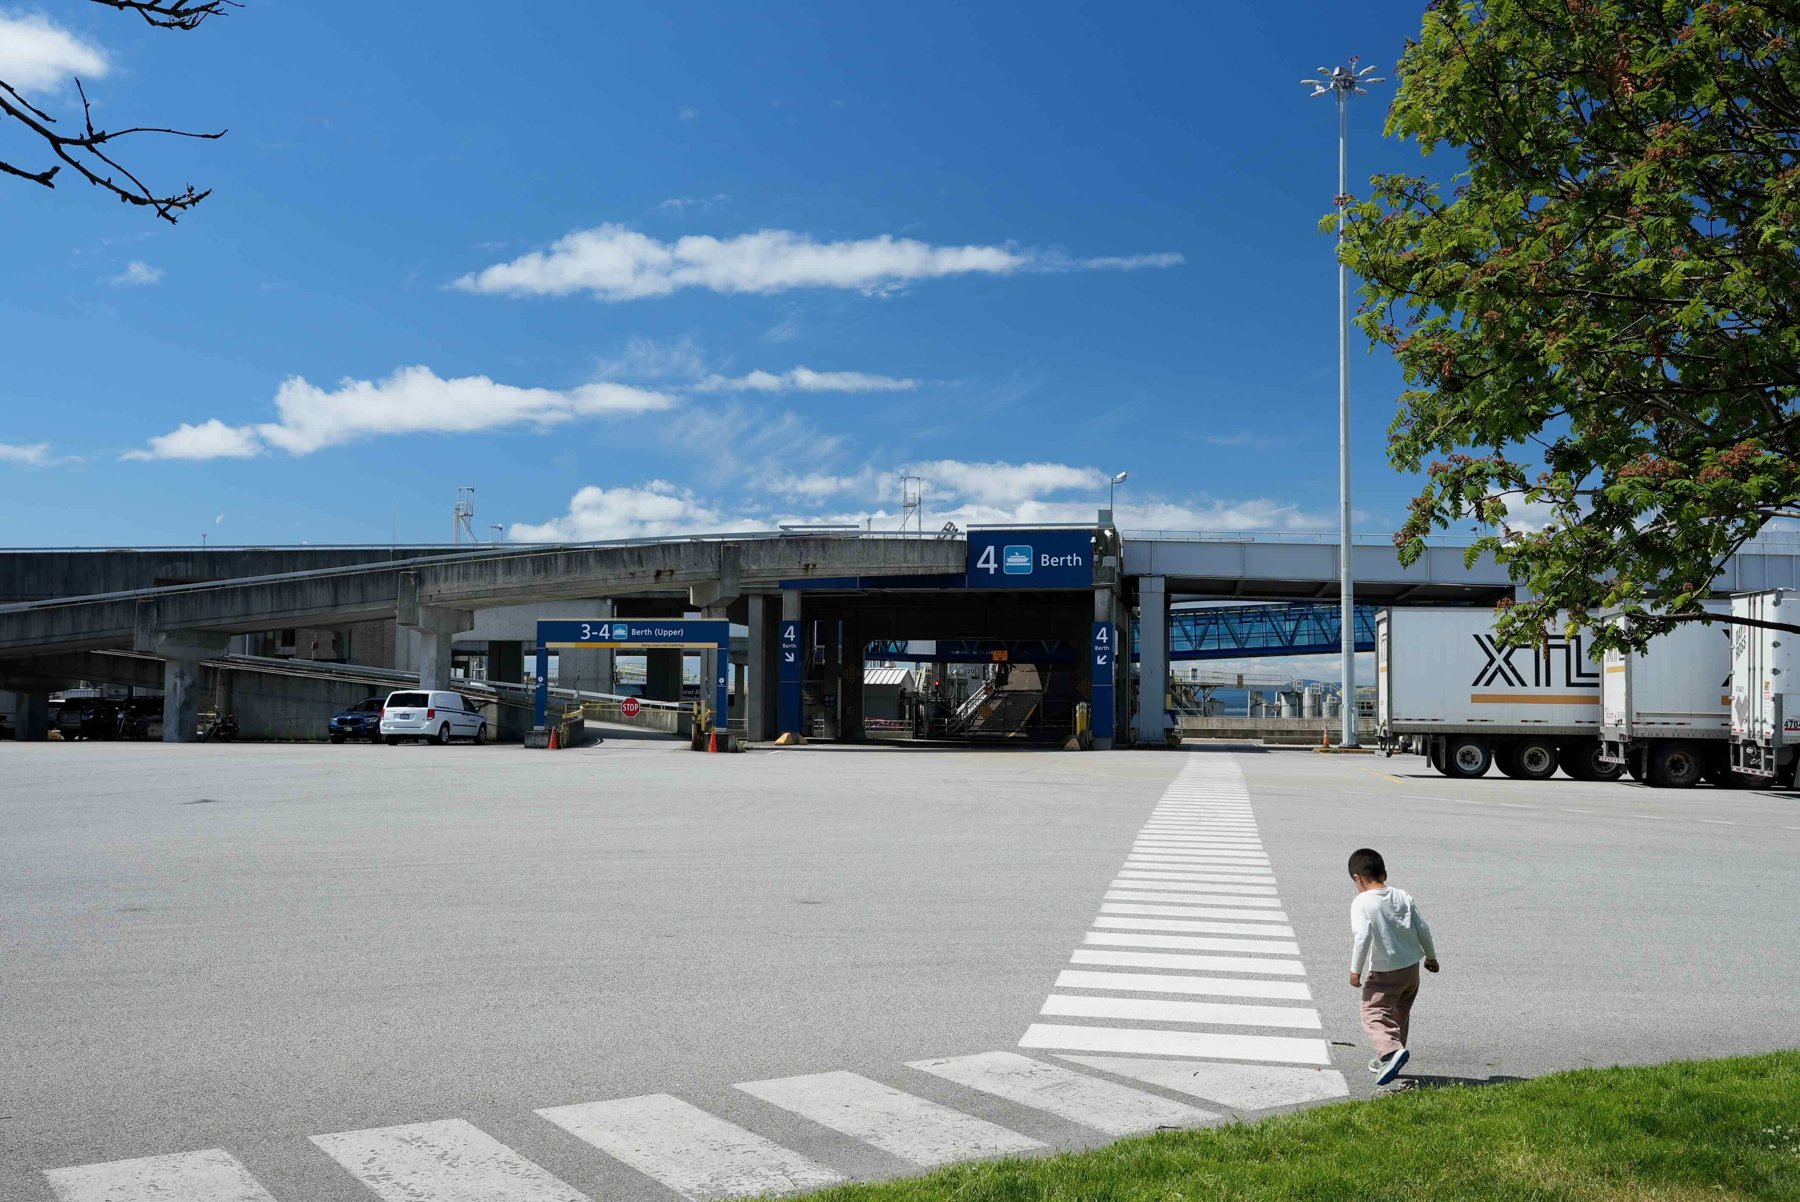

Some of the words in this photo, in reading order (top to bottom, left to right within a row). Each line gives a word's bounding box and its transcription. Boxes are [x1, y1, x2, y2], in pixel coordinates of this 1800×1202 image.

[976, 545, 998, 574] 4
[1041, 553, 1082, 567] Berth
[580, 624, 610, 640] 3-4
[631, 628, 652, 636] Berth
[655, 628, 684, 638] (Upper)
[783, 625, 796, 641] 4
[1096, 626, 1108, 643] 4
[622, 703, 639, 711] STOP
[1783, 720, 1800, 729] 470
